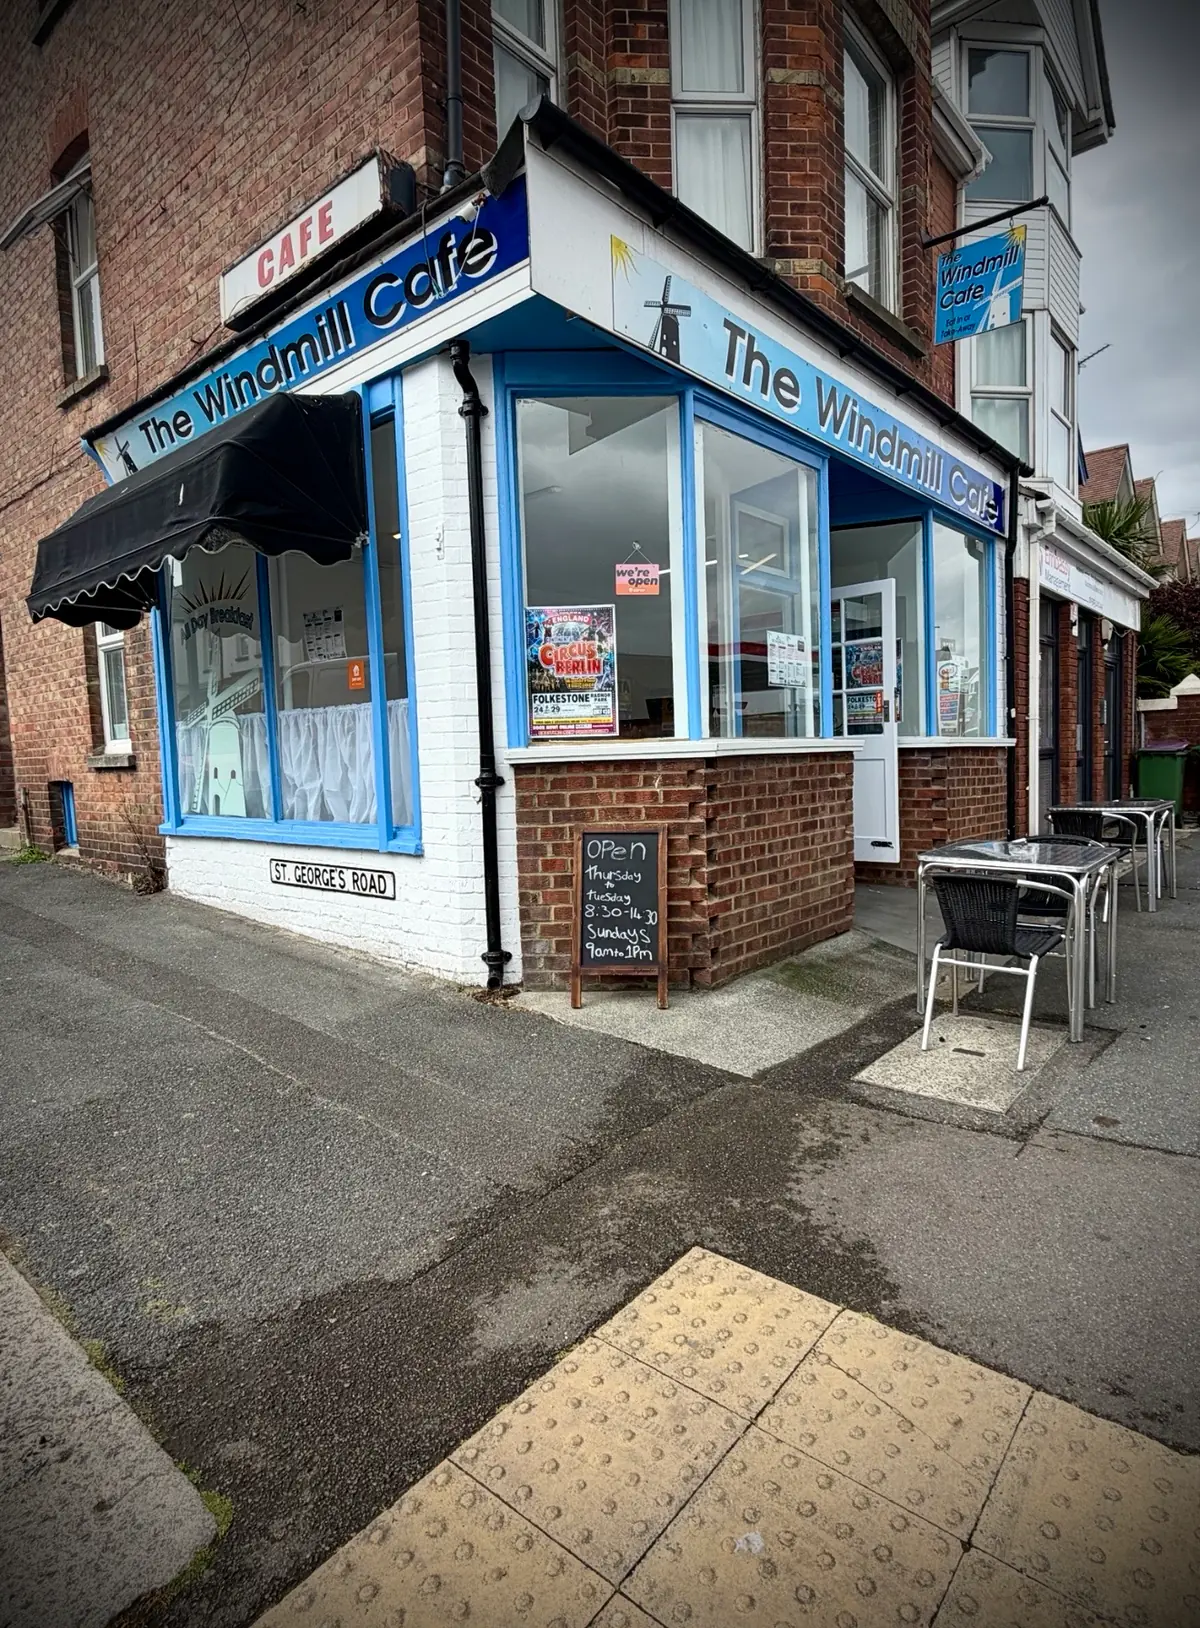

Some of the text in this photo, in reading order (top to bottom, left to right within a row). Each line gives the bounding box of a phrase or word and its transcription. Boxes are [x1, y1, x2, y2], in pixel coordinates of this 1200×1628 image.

[257, 200, 334, 288] CAFE
[941, 253, 962, 268] The
[941, 245, 1020, 288] Windmill
[940, 283, 984, 310] Cafe
[139, 227, 498, 453] The Windmill Cafe
[723, 318, 999, 524] The Windmill Cafe
[616, 567, 650, 577] we're
[628, 577, 658, 588] open
[190, 613, 208, 634] Day
[210, 606, 254, 630] Breakfast
[552, 615, 590, 623] ENGLAND
[540, 641, 597, 666] CIRCUS
[556, 659, 602, 675] BERLIN
[533, 694, 590, 704] FOLKESTONE
[275, 863, 387, 894] ST. GEORGE'S ROAD
[604, 881, 615, 889] to
